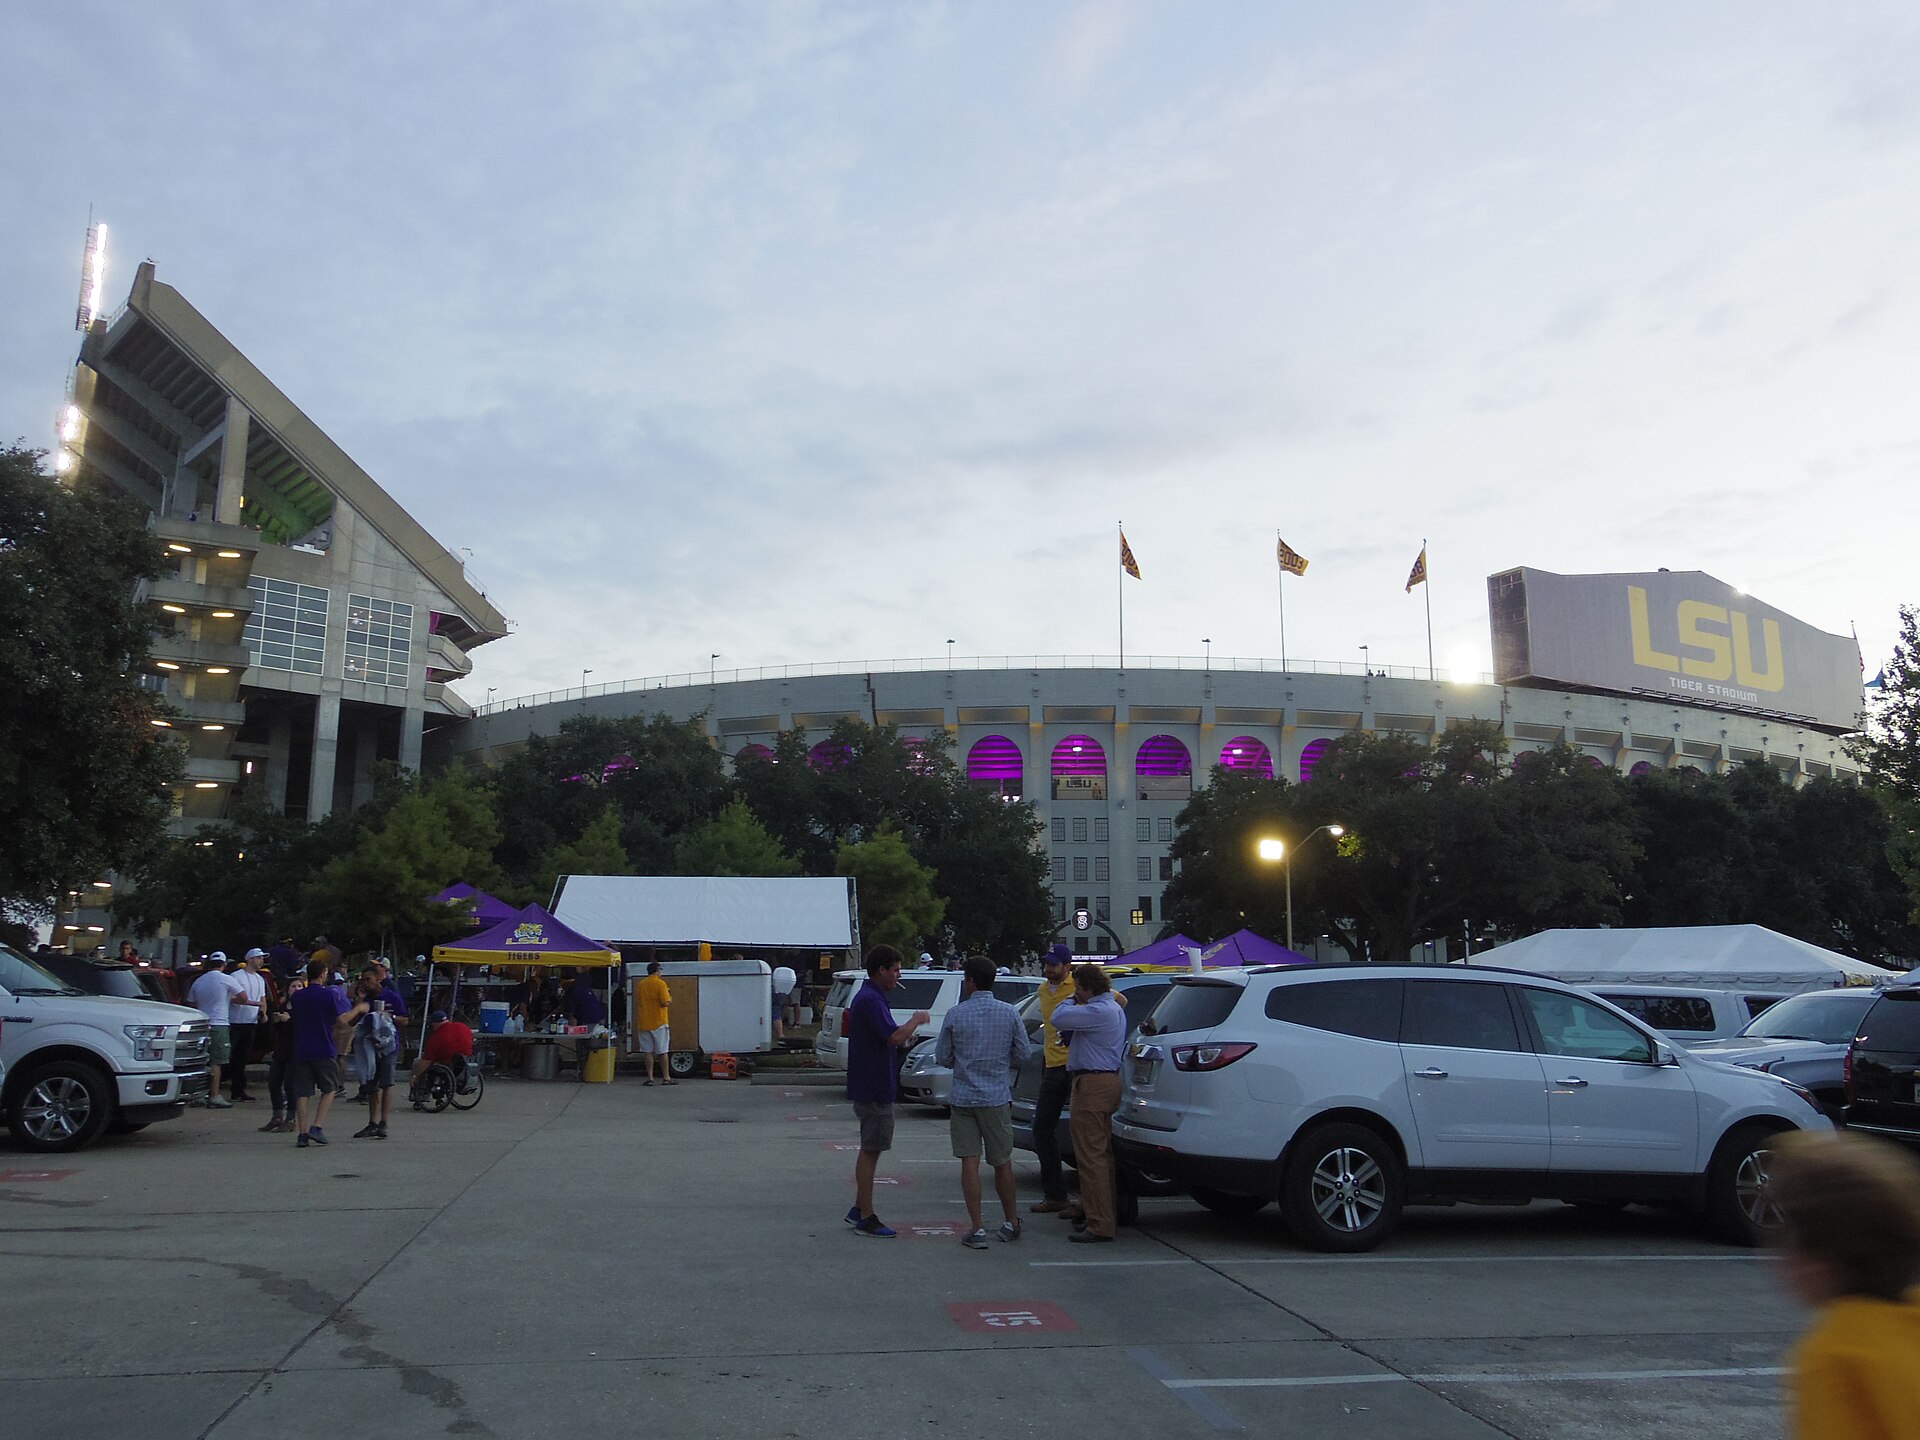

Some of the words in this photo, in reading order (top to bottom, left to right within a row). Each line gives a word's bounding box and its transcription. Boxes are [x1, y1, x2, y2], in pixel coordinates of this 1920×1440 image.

[1627, 585, 1784, 693] LSU
[1669, 677, 1703, 693] TIGER
[1708, 685, 1758, 703] STADIUM
[1077, 915, 1088, 930] 8
[507, 952, 540, 961] TIGERS
[978, 1310, 1043, 1327] 15
